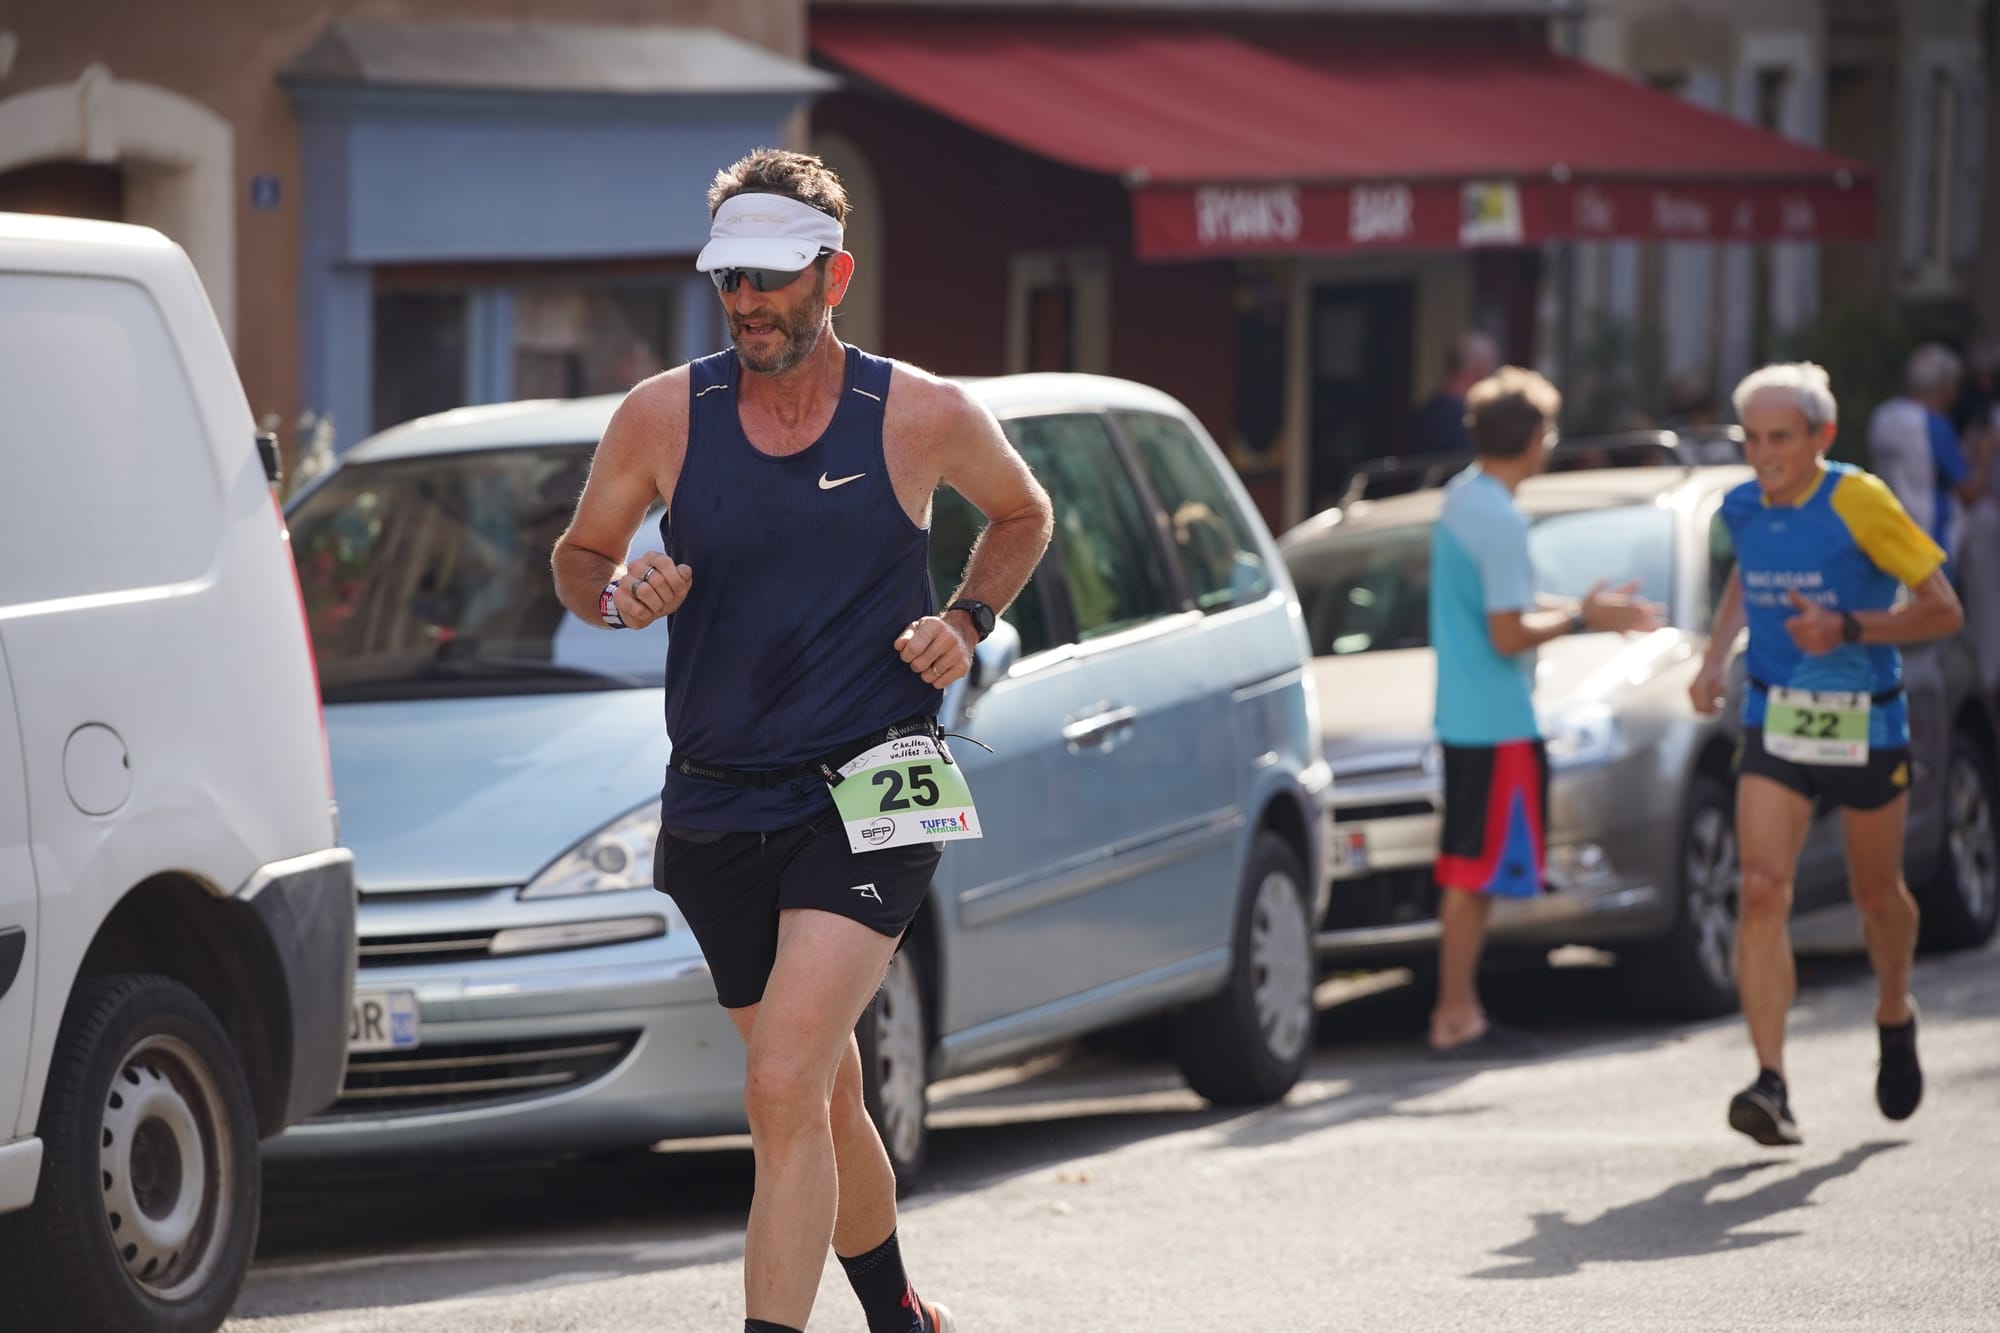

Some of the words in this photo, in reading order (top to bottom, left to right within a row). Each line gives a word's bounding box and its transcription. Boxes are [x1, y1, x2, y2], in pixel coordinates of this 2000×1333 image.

[1792, 709, 1840, 739] 22
[871, 764, 940, 812] 25
[919, 817, 957, 829] TUFF'S
[861, 826, 891, 838] BFP
[926, 825, 962, 834] Aventure
